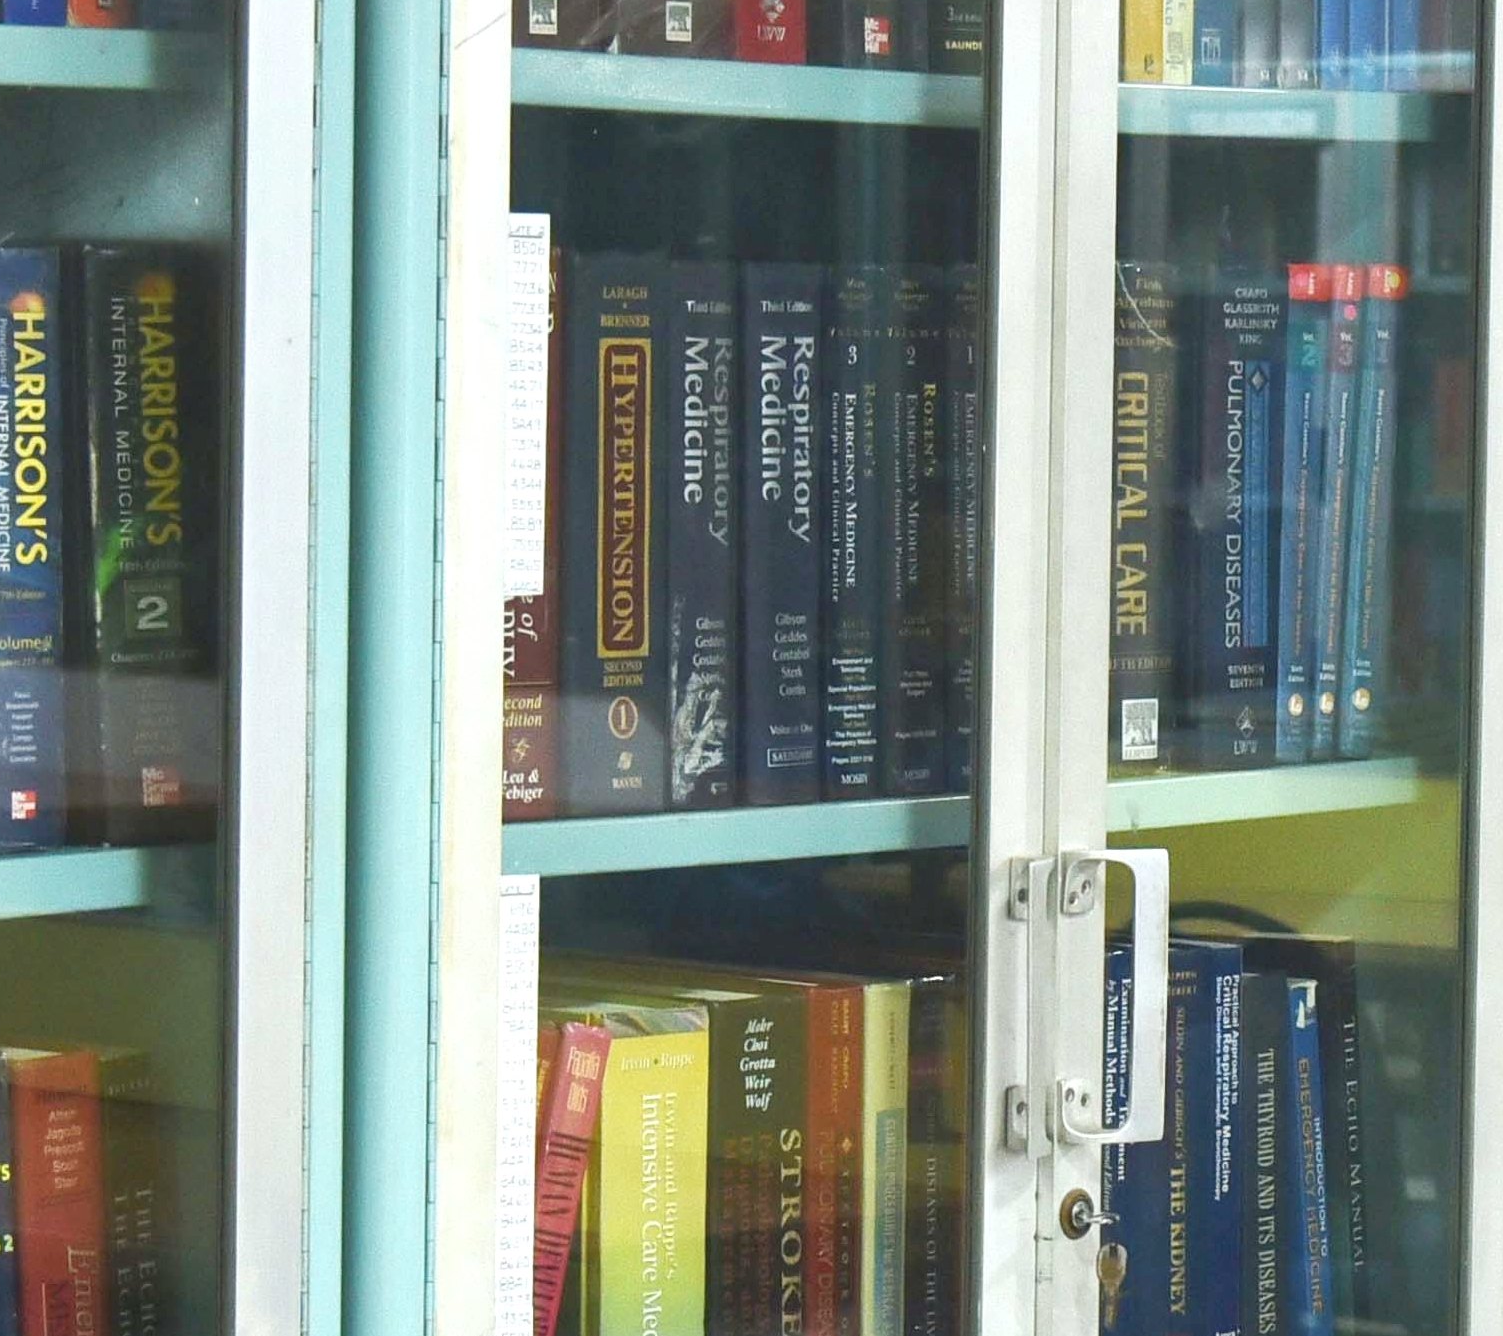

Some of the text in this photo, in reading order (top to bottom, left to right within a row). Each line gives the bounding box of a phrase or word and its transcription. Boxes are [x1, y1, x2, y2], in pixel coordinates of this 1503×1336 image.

[12, 311, 48, 566] HARRISON'S
[139, 297, 183, 547] HARRISON'S
[610, 352, 637, 644] HYPERTENSION
[684, 335, 708, 505] Medicine
[761, 334, 783, 503] Medicine
[788, 335, 815, 544] Respiratory
[1115, 371, 1150, 637] CRITICAL CARE
[1224, 360, 1244, 649] PULMONARY DISEASES
[640, 1093, 662, 1214] Intensive
[641, 1219, 663, 1283] Care
[1169, 1163, 1188, 1317] THE KIDNEY
